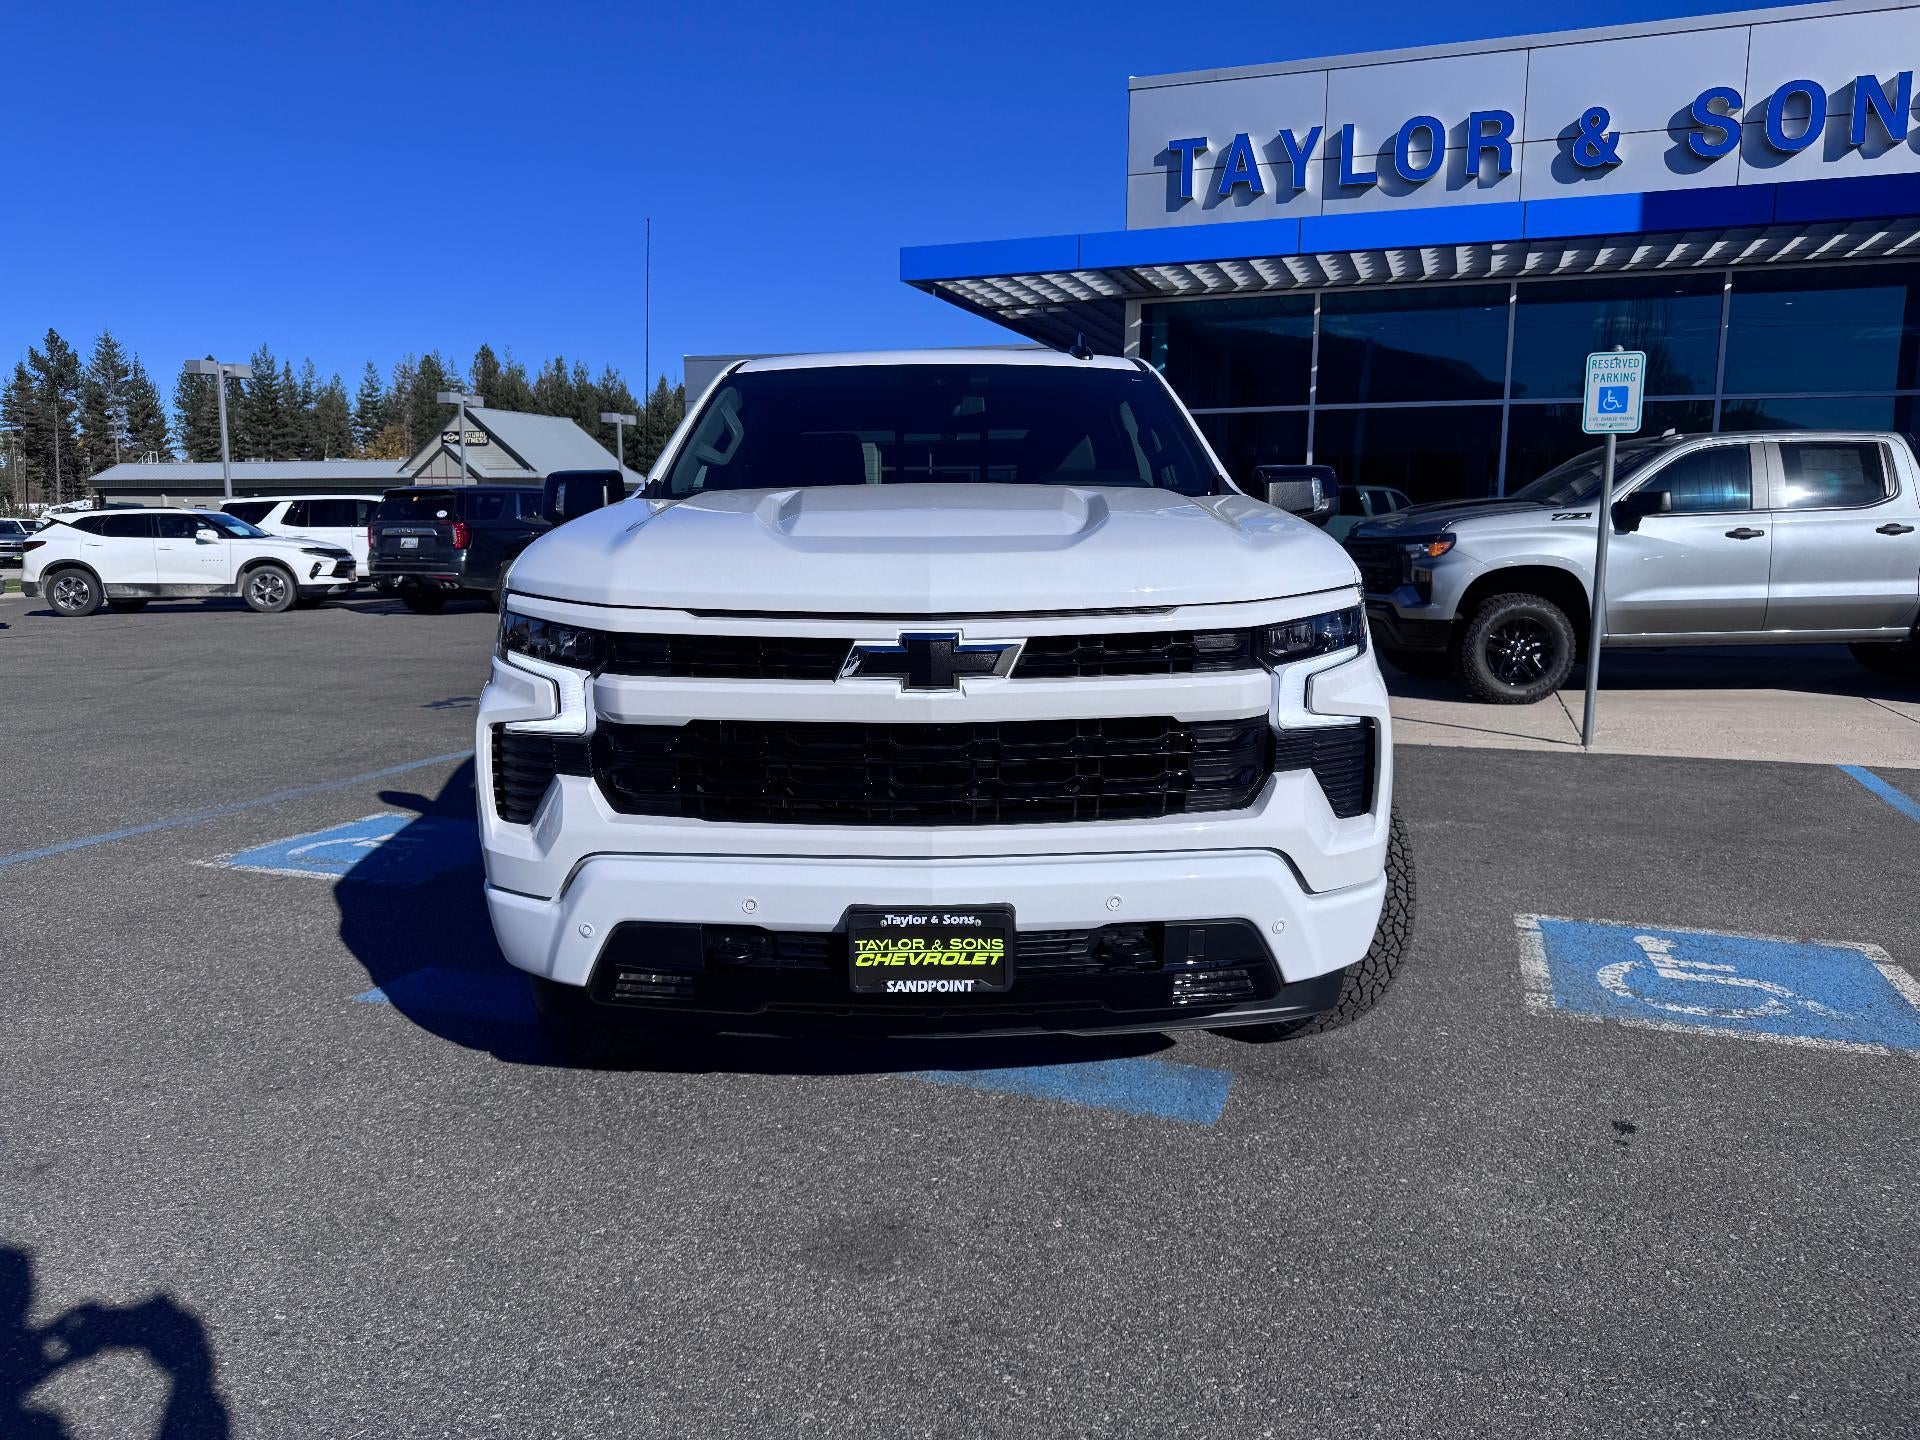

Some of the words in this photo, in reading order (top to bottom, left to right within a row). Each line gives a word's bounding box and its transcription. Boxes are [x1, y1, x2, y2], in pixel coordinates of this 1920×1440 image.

[1168, 108, 1516, 199] TAYLOR
[1572, 106, 1623, 168] &
[1688, 70, 1920, 159] SON
[1591, 358, 1640, 370] RESERVED
[1593, 372, 1637, 383] PARKING
[885, 914, 928, 928] Taylor
[930, 915, 939, 924] &
[942, 914, 975, 925] Sons
[854, 938, 925, 951] TAYLOR
[931, 939, 944, 952] &
[949, 938, 1004, 950] SONS
[855, 952, 1005, 967] CHEVROLET
[886, 979, 975, 993] SANDPOINT
